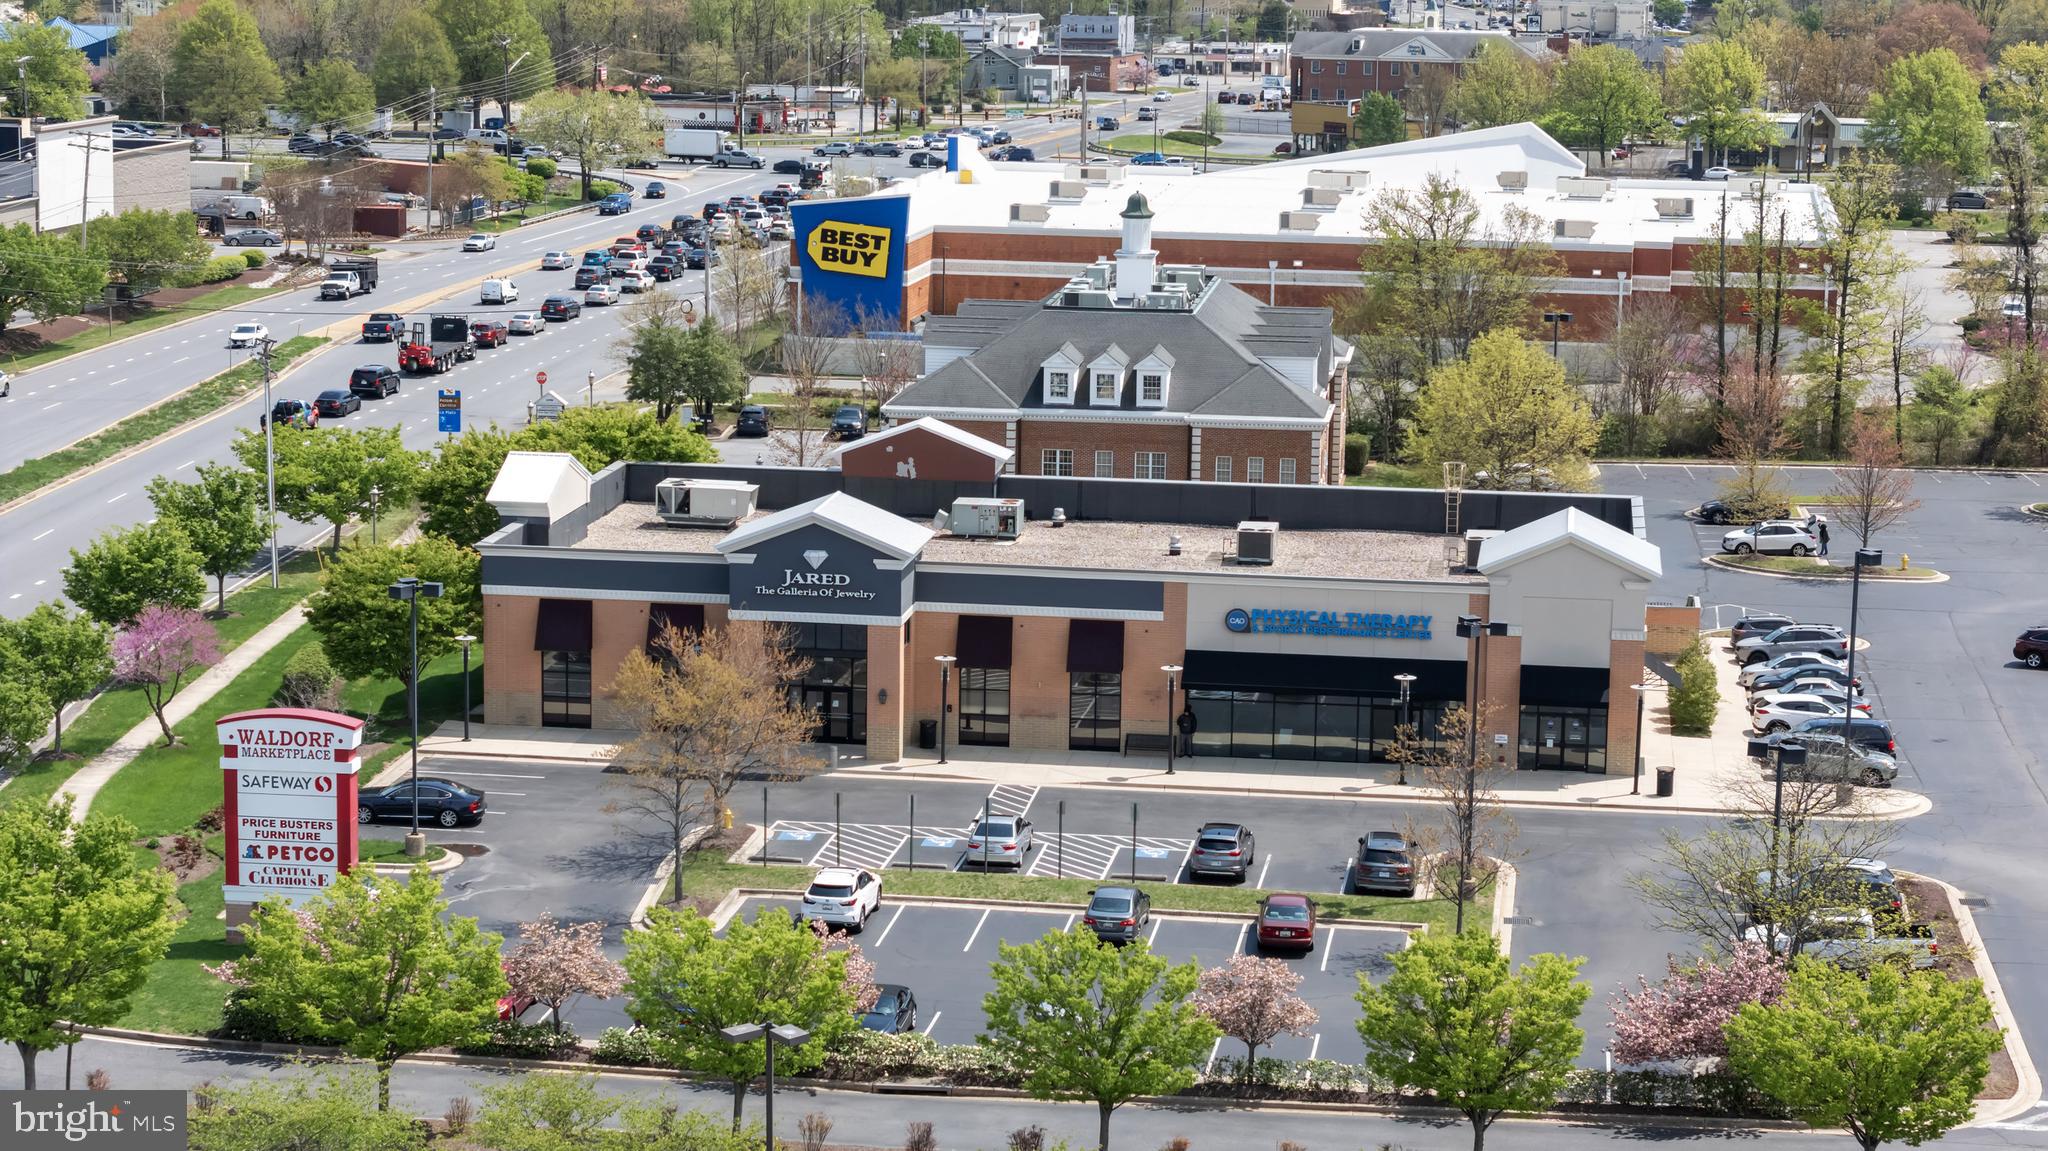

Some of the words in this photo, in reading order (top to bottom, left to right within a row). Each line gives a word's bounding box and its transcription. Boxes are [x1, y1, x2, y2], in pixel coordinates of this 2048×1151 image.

[820, 228, 886, 251] BEST
[821, 246, 879, 267] BUY
[781, 569, 851, 586] JARED
[755, 586, 775, 595] The
[777, 587, 818, 597] Galleria
[819, 588, 833, 597] Of
[835, 589, 876, 600] Jewelry
[1252, 608, 1341, 627] PHYSICAL
[1345, 612, 1433, 631] THERAPY
[1263, 624, 1303, 635] SPORTS
[1306, 625, 1389, 639] PERFORMANCE
[1391, 629, 1432, 640] CENTER
[237, 729, 335, 748] WALDORF
[241, 747, 331, 761] MARKETPLACE
[242, 774, 312, 790] SAFEWAY
[242, 818, 277, 828] PRICE
[280, 820, 333, 831] BUSTERS
[255, 830, 321, 841] FURNITURE
[267, 845, 335, 863] PETCO
[263, 866, 315, 877] CAPITAL
